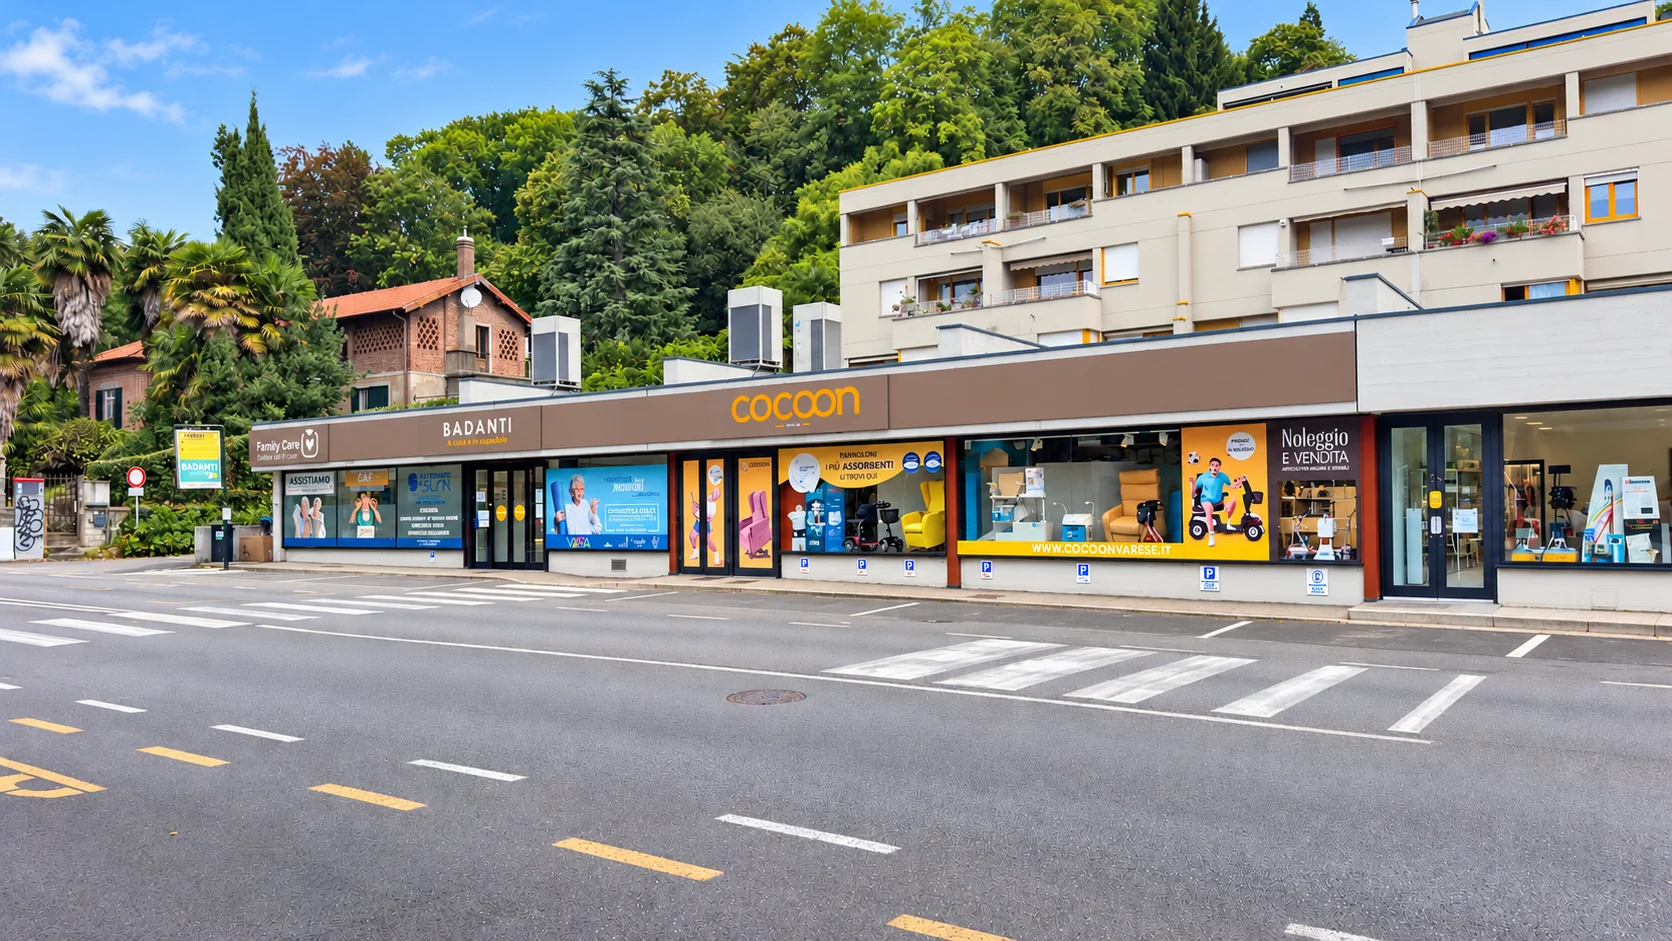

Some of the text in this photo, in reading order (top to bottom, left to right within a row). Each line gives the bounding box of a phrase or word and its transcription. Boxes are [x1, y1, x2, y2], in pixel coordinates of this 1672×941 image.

[731, 386, 860, 423] cocoon
[443, 417, 512, 437] BADANTI
[256, 439, 300, 454] Family Care
[1282, 427, 1349, 451] Noleggio
[1282, 450, 1349, 465] E VENDITA
[181, 462, 218, 471] BADANTI
[842, 460, 894, 471] ASSORBENTI
[357, 472, 374, 483] CAF
[1032, 543, 1171, 555] WWW.COCOONVARESE.IT
